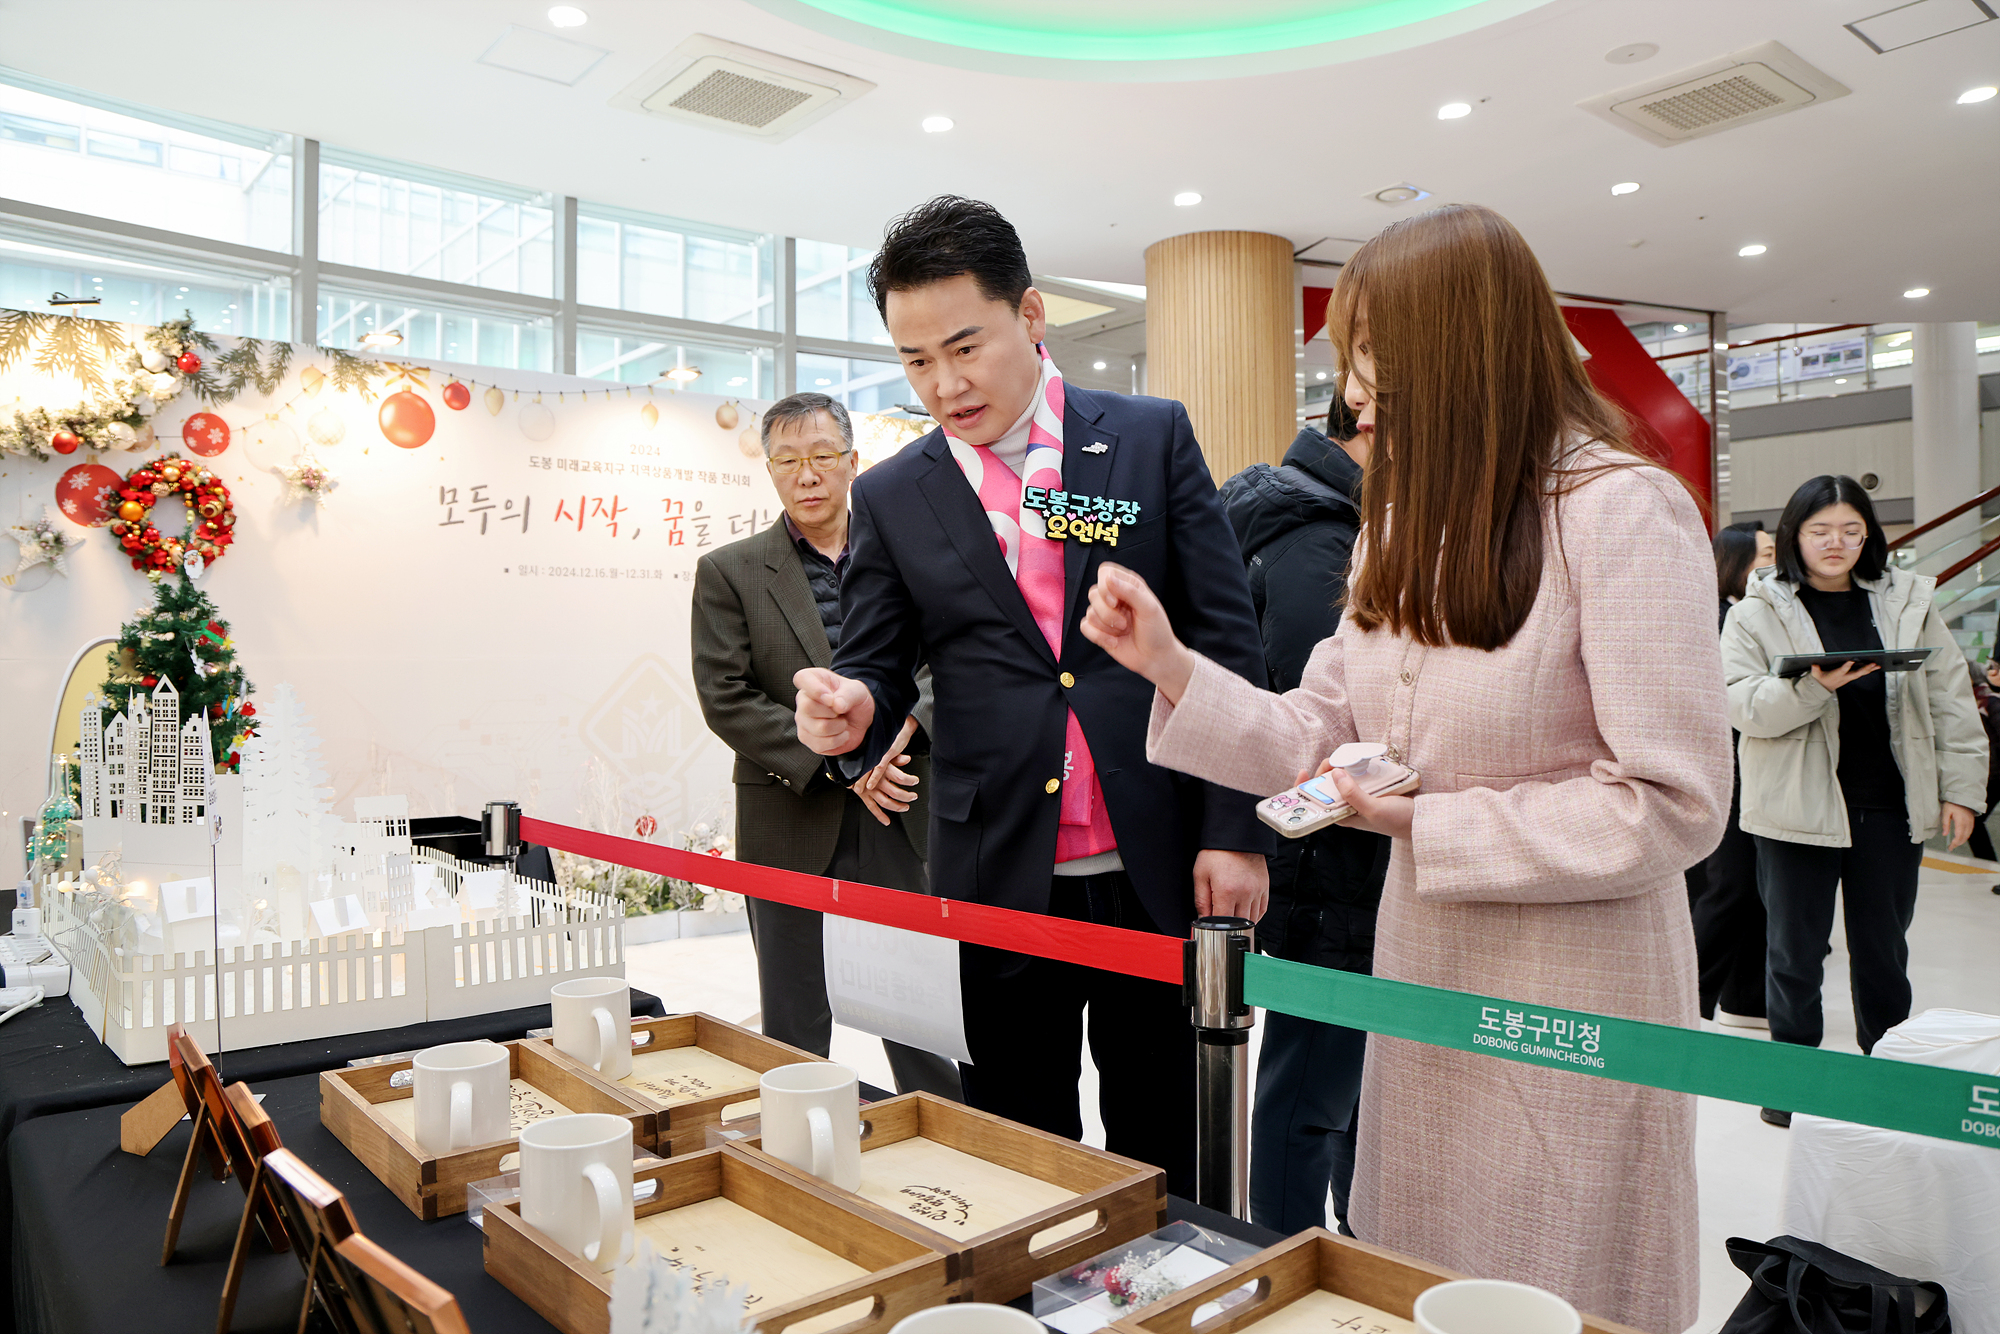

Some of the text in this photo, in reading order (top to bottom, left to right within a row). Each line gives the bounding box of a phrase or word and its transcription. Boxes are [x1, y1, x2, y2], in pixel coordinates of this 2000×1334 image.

[630, 444, 660, 456] 2024
[528, 456, 750, 487] 도봉 미래교육지구 지역상품개발 작품 전시회
[438, 485, 530, 535] 모두의
[554, 495, 641, 540] 시작,
[661, 498, 712, 547] 꿈을
[1024, 486, 1141, 525] 도봉구청장
[1047, 515, 1119, 547] 오연석
[518, 564, 538, 577] 일시
[1478, 1006, 1600, 1053] 도봉구민청
[1473, 1033, 1605, 1069] DOBONG GUMINCHEONG
